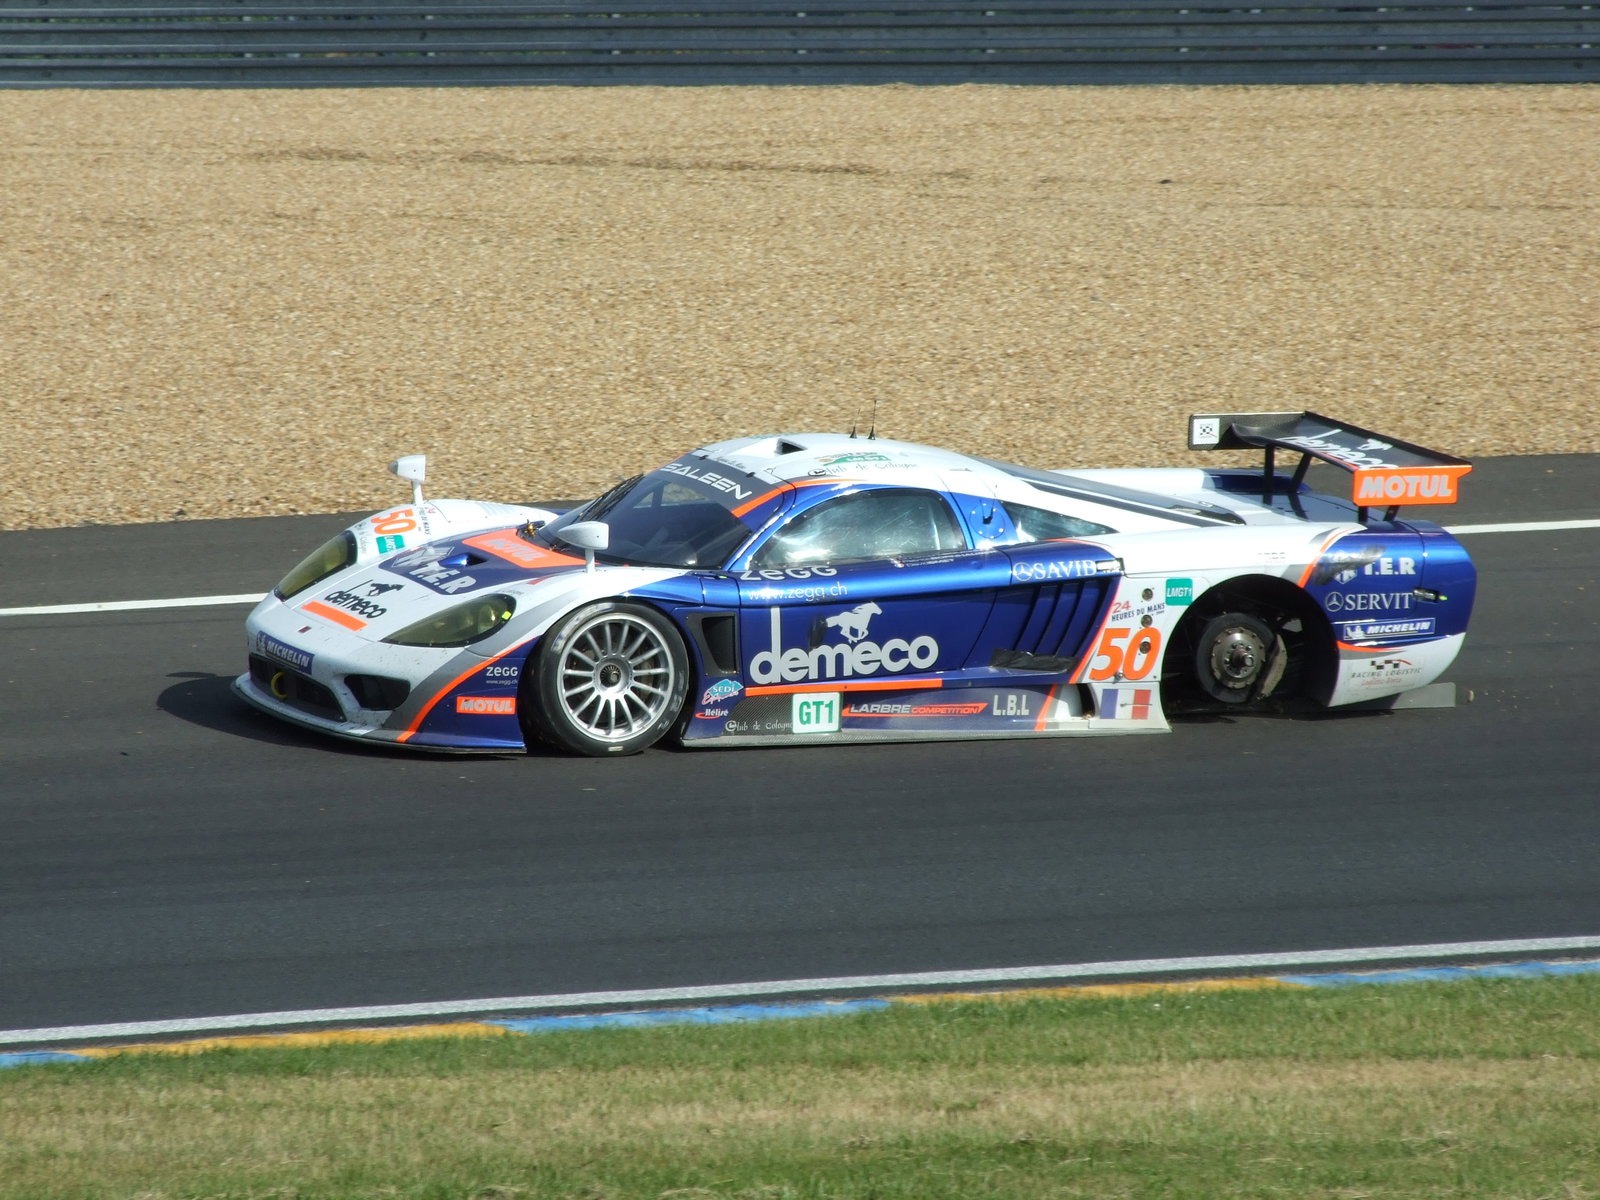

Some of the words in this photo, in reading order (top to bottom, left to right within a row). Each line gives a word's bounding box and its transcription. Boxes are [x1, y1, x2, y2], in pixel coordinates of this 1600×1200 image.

[660, 463, 752, 500] SALEEN
[1358, 475, 1452, 498] MOTUL
[370, 508, 417, 534] 50
[324, 579, 388, 619] demeco
[1167, 587, 1192, 598] LMGT1
[1345, 592, 1413, 611] SERVIT
[1112, 600, 1131, 614] 24
[1112, 610, 1135, 622] HEURES
[1136, 607, 1145, 616] DU
[1147, 602, 1165, 613] MANS
[1367, 622, 1431, 634] MICHELIN
[265, 639, 311, 668] MICHELIN
[750, 606, 939, 685] demeco
[1089, 627, 1162, 680] 50
[1351, 670, 1382, 679] RACING
[1385, 667, 1422, 677] LOGISTIC
[460, 699, 513, 712] MOTUL
[799, 700, 834, 726] GT1
[851, 704, 911, 714] LARBRE
[911, 706, 980, 715] COMPETITION
[992, 695, 1030, 716] L.B.L
[725, 720, 748, 732] Club
[753, 720, 760, 731] de
